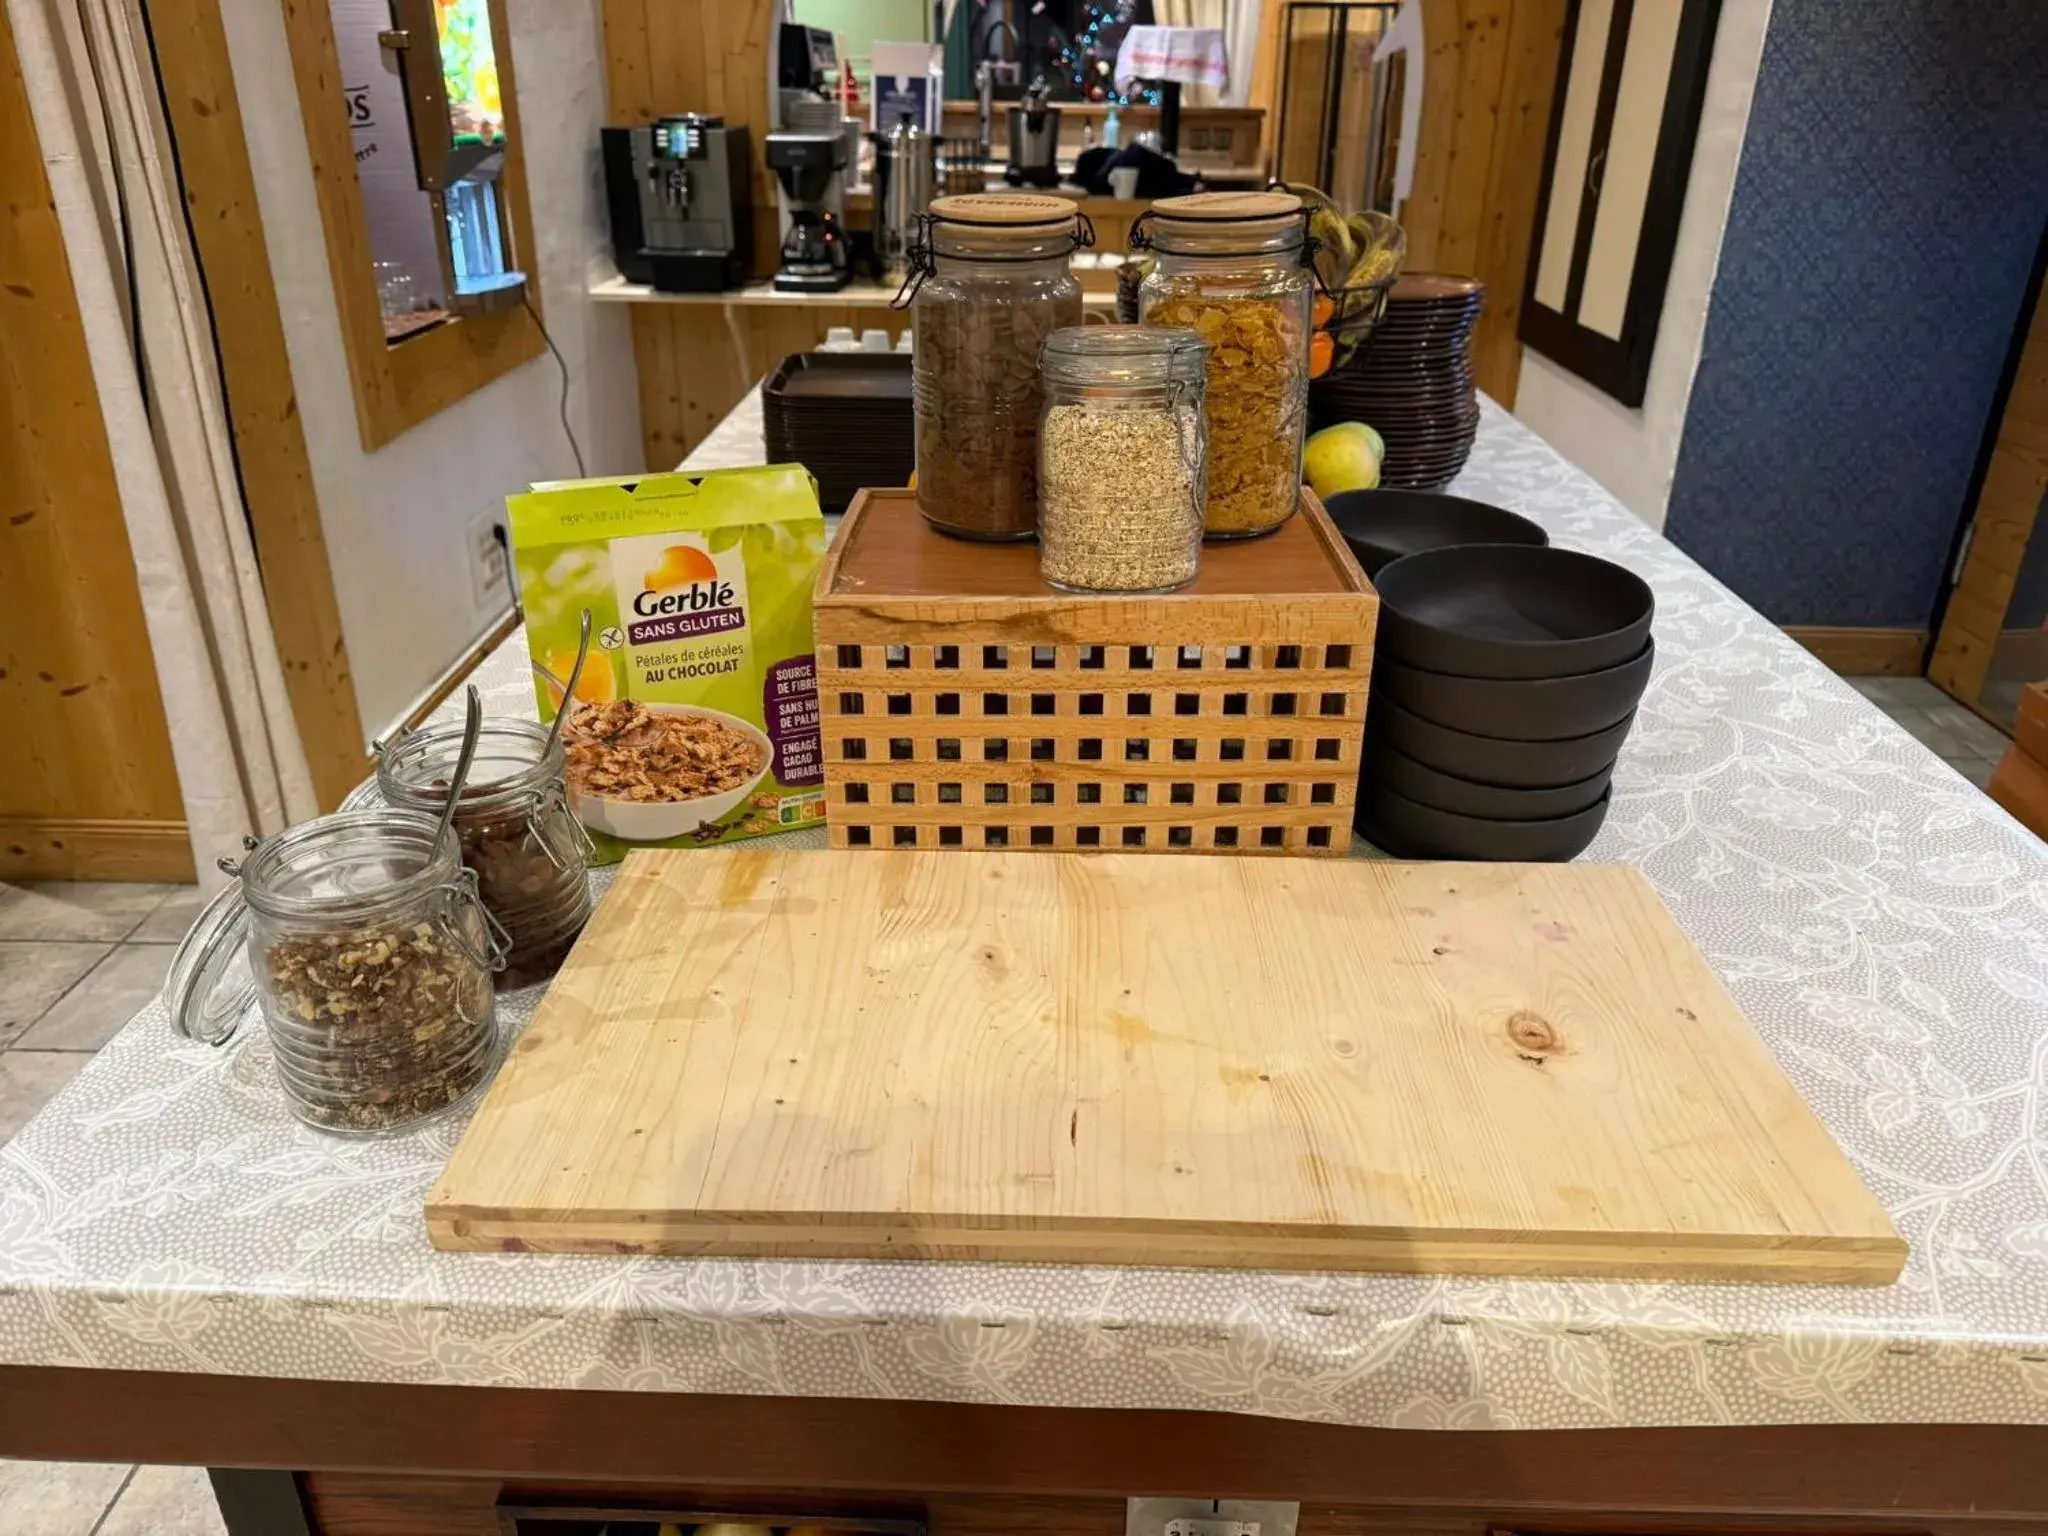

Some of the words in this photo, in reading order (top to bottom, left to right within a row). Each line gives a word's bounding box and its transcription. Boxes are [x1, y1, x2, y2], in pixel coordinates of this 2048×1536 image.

[633, 581, 734, 616] Gerblé
[634, 622, 676, 639] SANS
[679, 612, 740, 632] GLUTEN
[636, 652, 678, 668] Pétales
[681, 649, 696, 662] de
[698, 643, 744, 660] céréales
[645, 671, 664, 683] AU
[668, 659, 739, 680] CHOCOLAT
[776, 666, 811, 681] SOURCE
[777, 683, 790, 695] DE
[779, 703, 803, 716] SANS
[780, 718, 792, 729] DE
[782, 738, 818, 756] ENGAGÉ
[783, 754, 813, 768] CACAO
